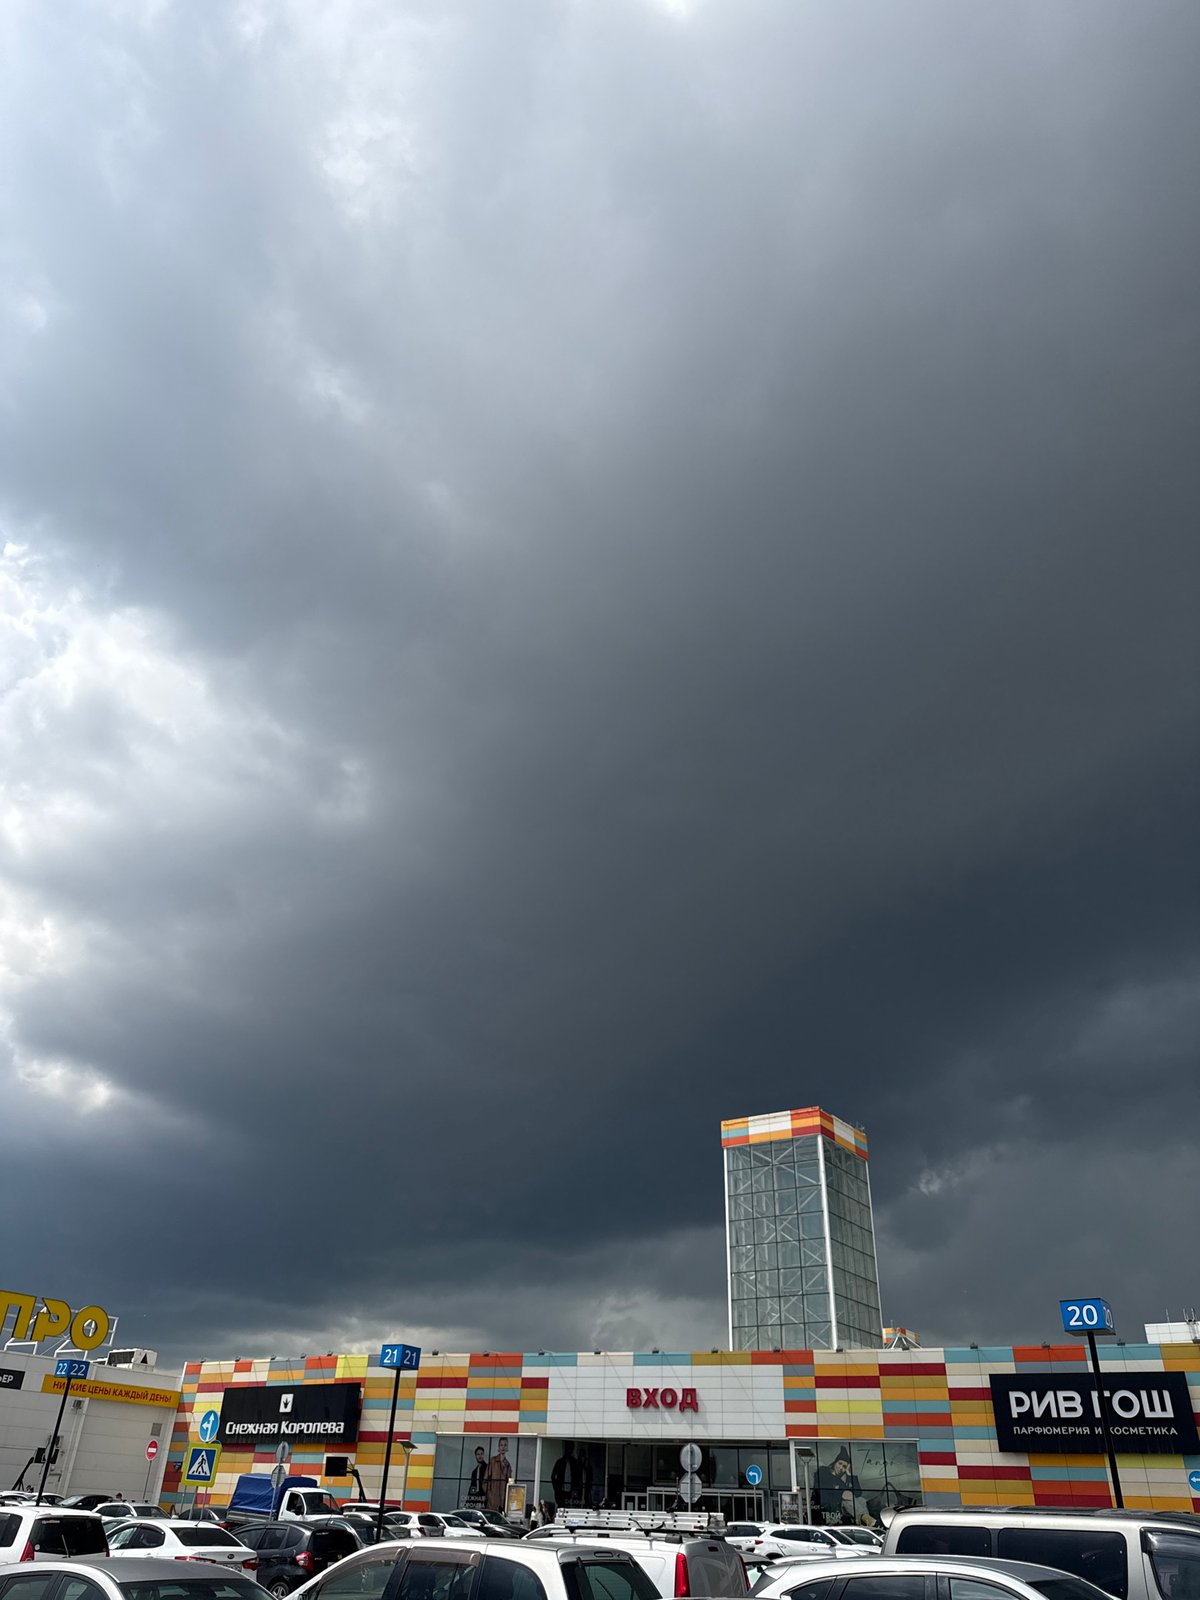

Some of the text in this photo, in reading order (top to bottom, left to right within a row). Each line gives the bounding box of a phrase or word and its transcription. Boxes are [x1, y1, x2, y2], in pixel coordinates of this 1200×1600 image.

[1067, 1304, 1098, 1326] 20
[383, 1349, 398, 1363] 21
[403, 1350, 417, 1366] 21
[56, 1363, 68, 1375] 22
[70, 1363, 86, 1376] 22
[53, 1381, 87, 1393] НИКИЕ
[87, 1385, 111, 1396] ЦЕНЫ
[112, 1389, 148, 1400] КАЖДЫЙ
[626, 1387, 699, 1413] ВХОД
[1008, 1389, 1174, 1419] РИВ ГОШ
[225, 1421, 344, 1434] Снежная Королева
[1013, 1426, 1090, 1435] ПАРФЮМЕРИЯ
[1094, 1426, 1102, 1435] И
